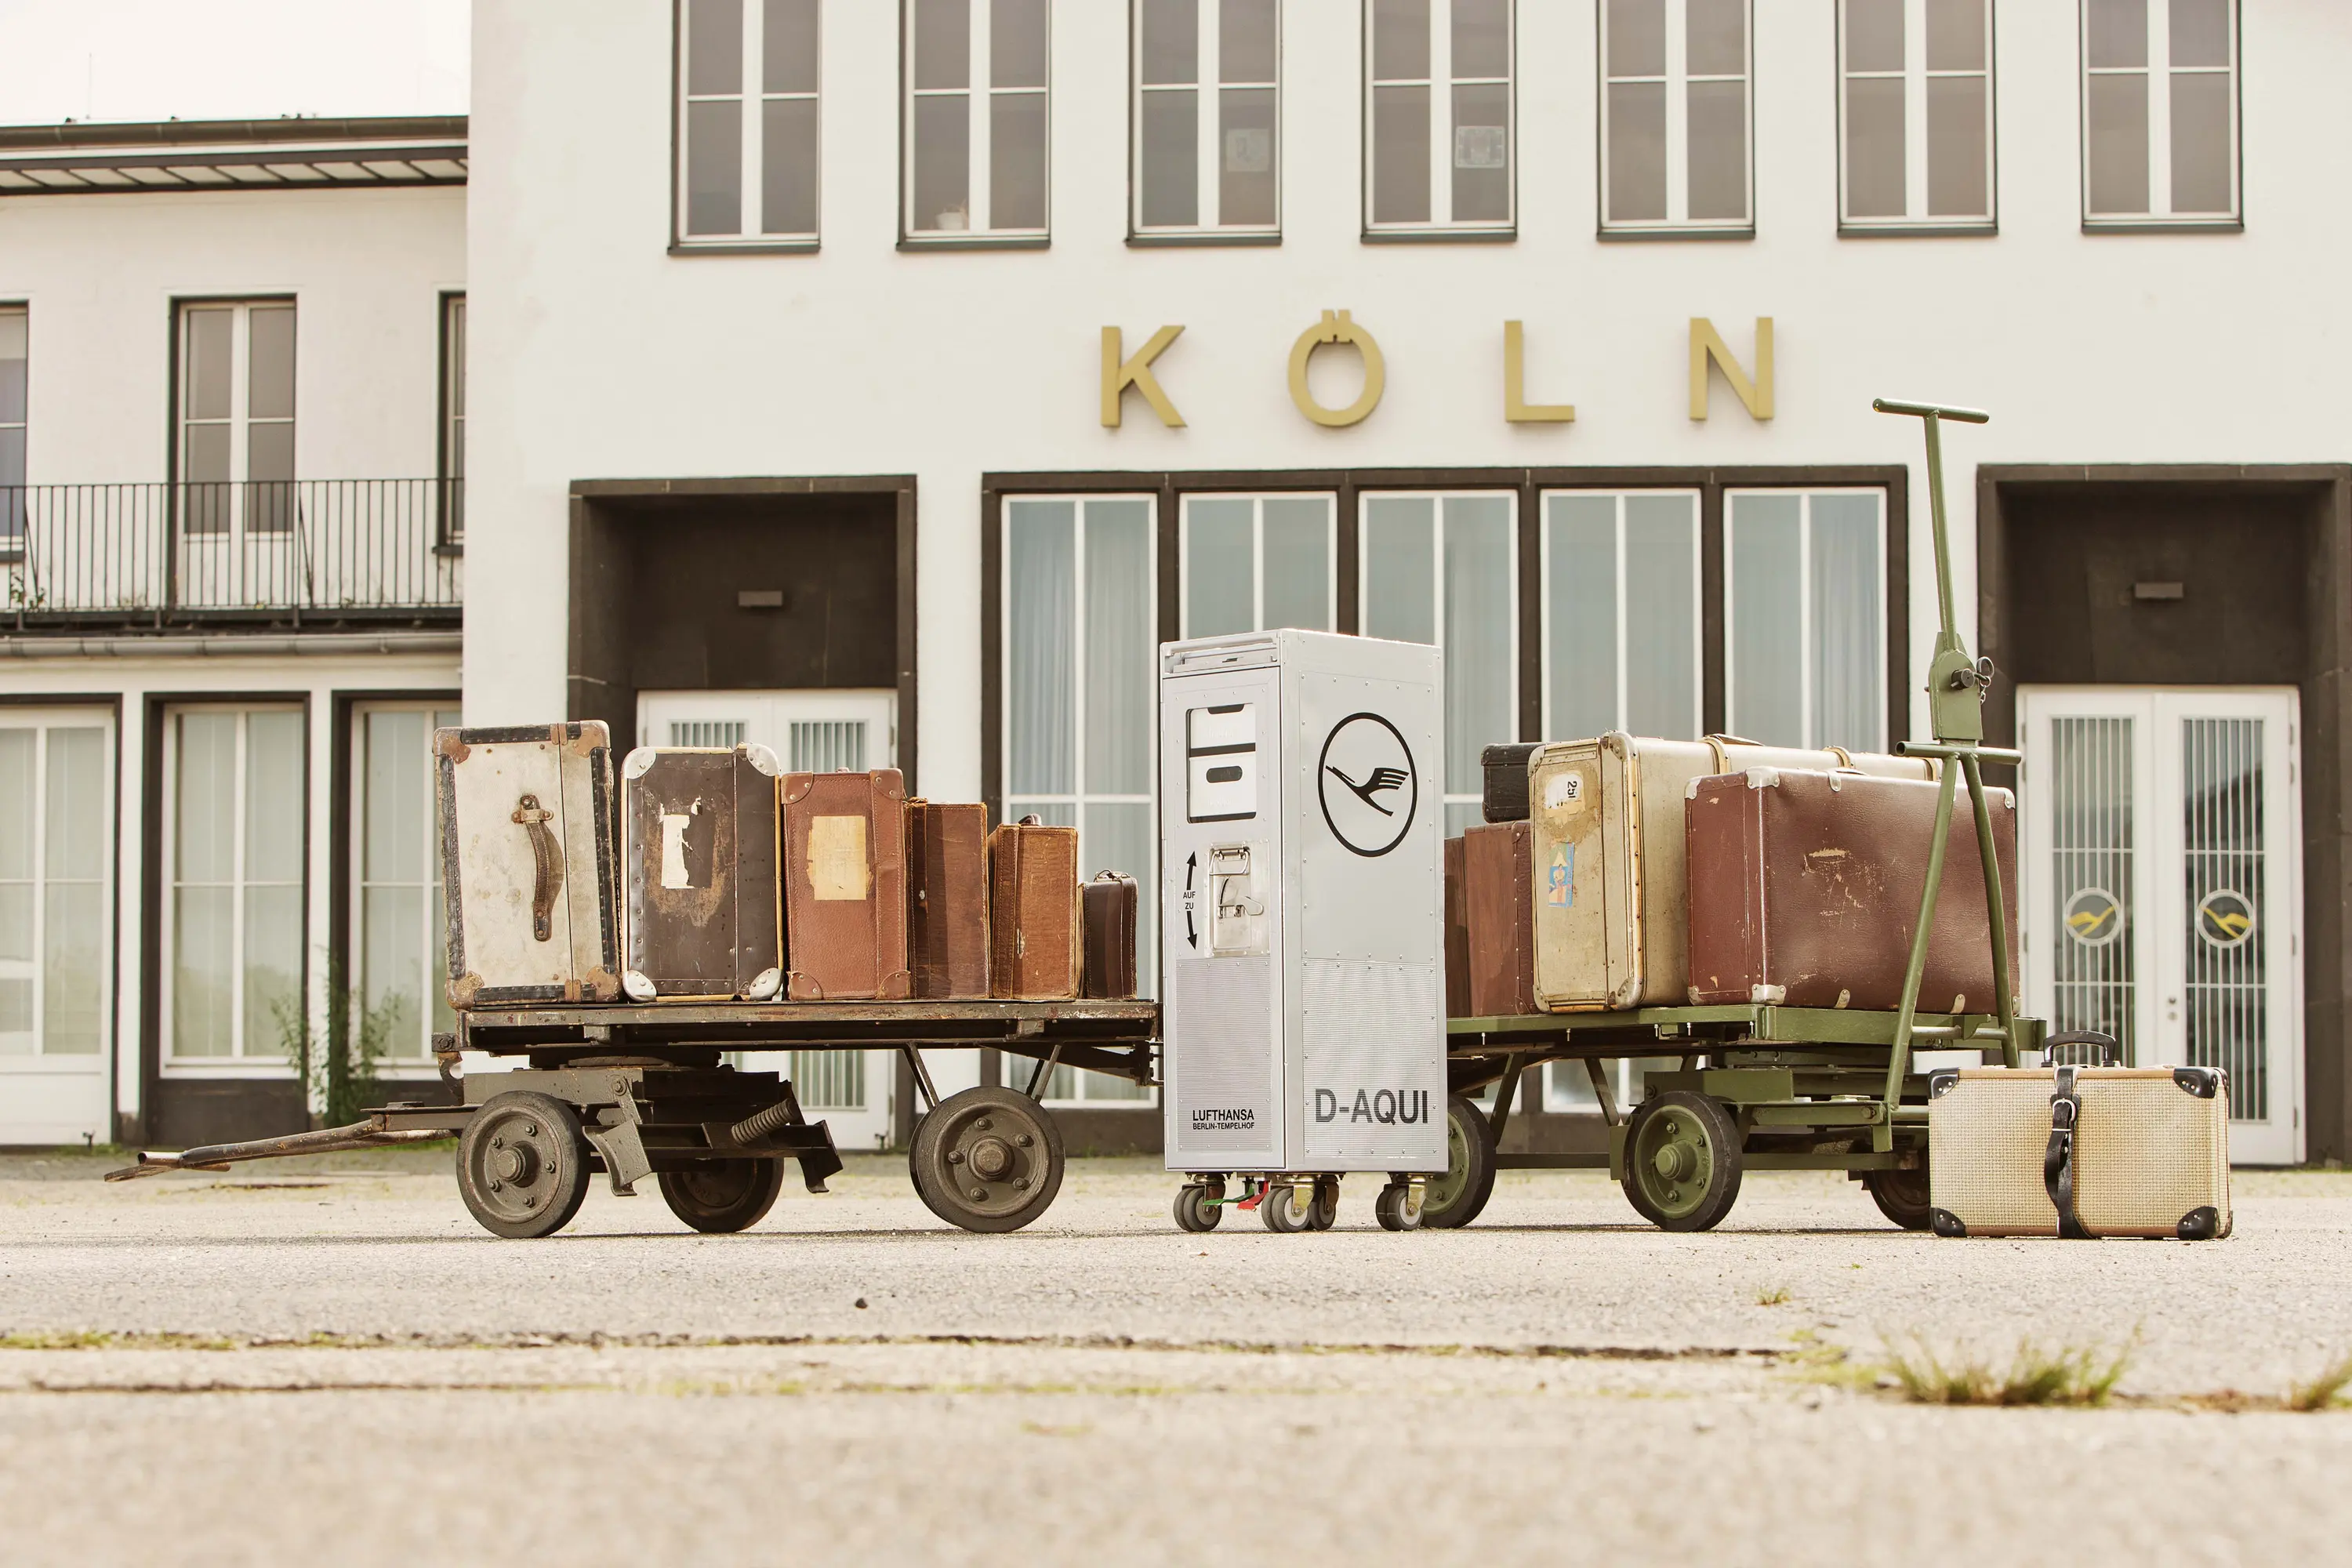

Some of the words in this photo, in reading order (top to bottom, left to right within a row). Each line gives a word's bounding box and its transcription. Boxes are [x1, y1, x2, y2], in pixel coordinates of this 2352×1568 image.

[1100, 309, 1774, 430] KÖLN
[1182, 891, 1196, 899] AUF
[1192, 1109, 1254, 1121] LUFTHANSA
[1315, 1088, 1428, 1126] D-AQUI
